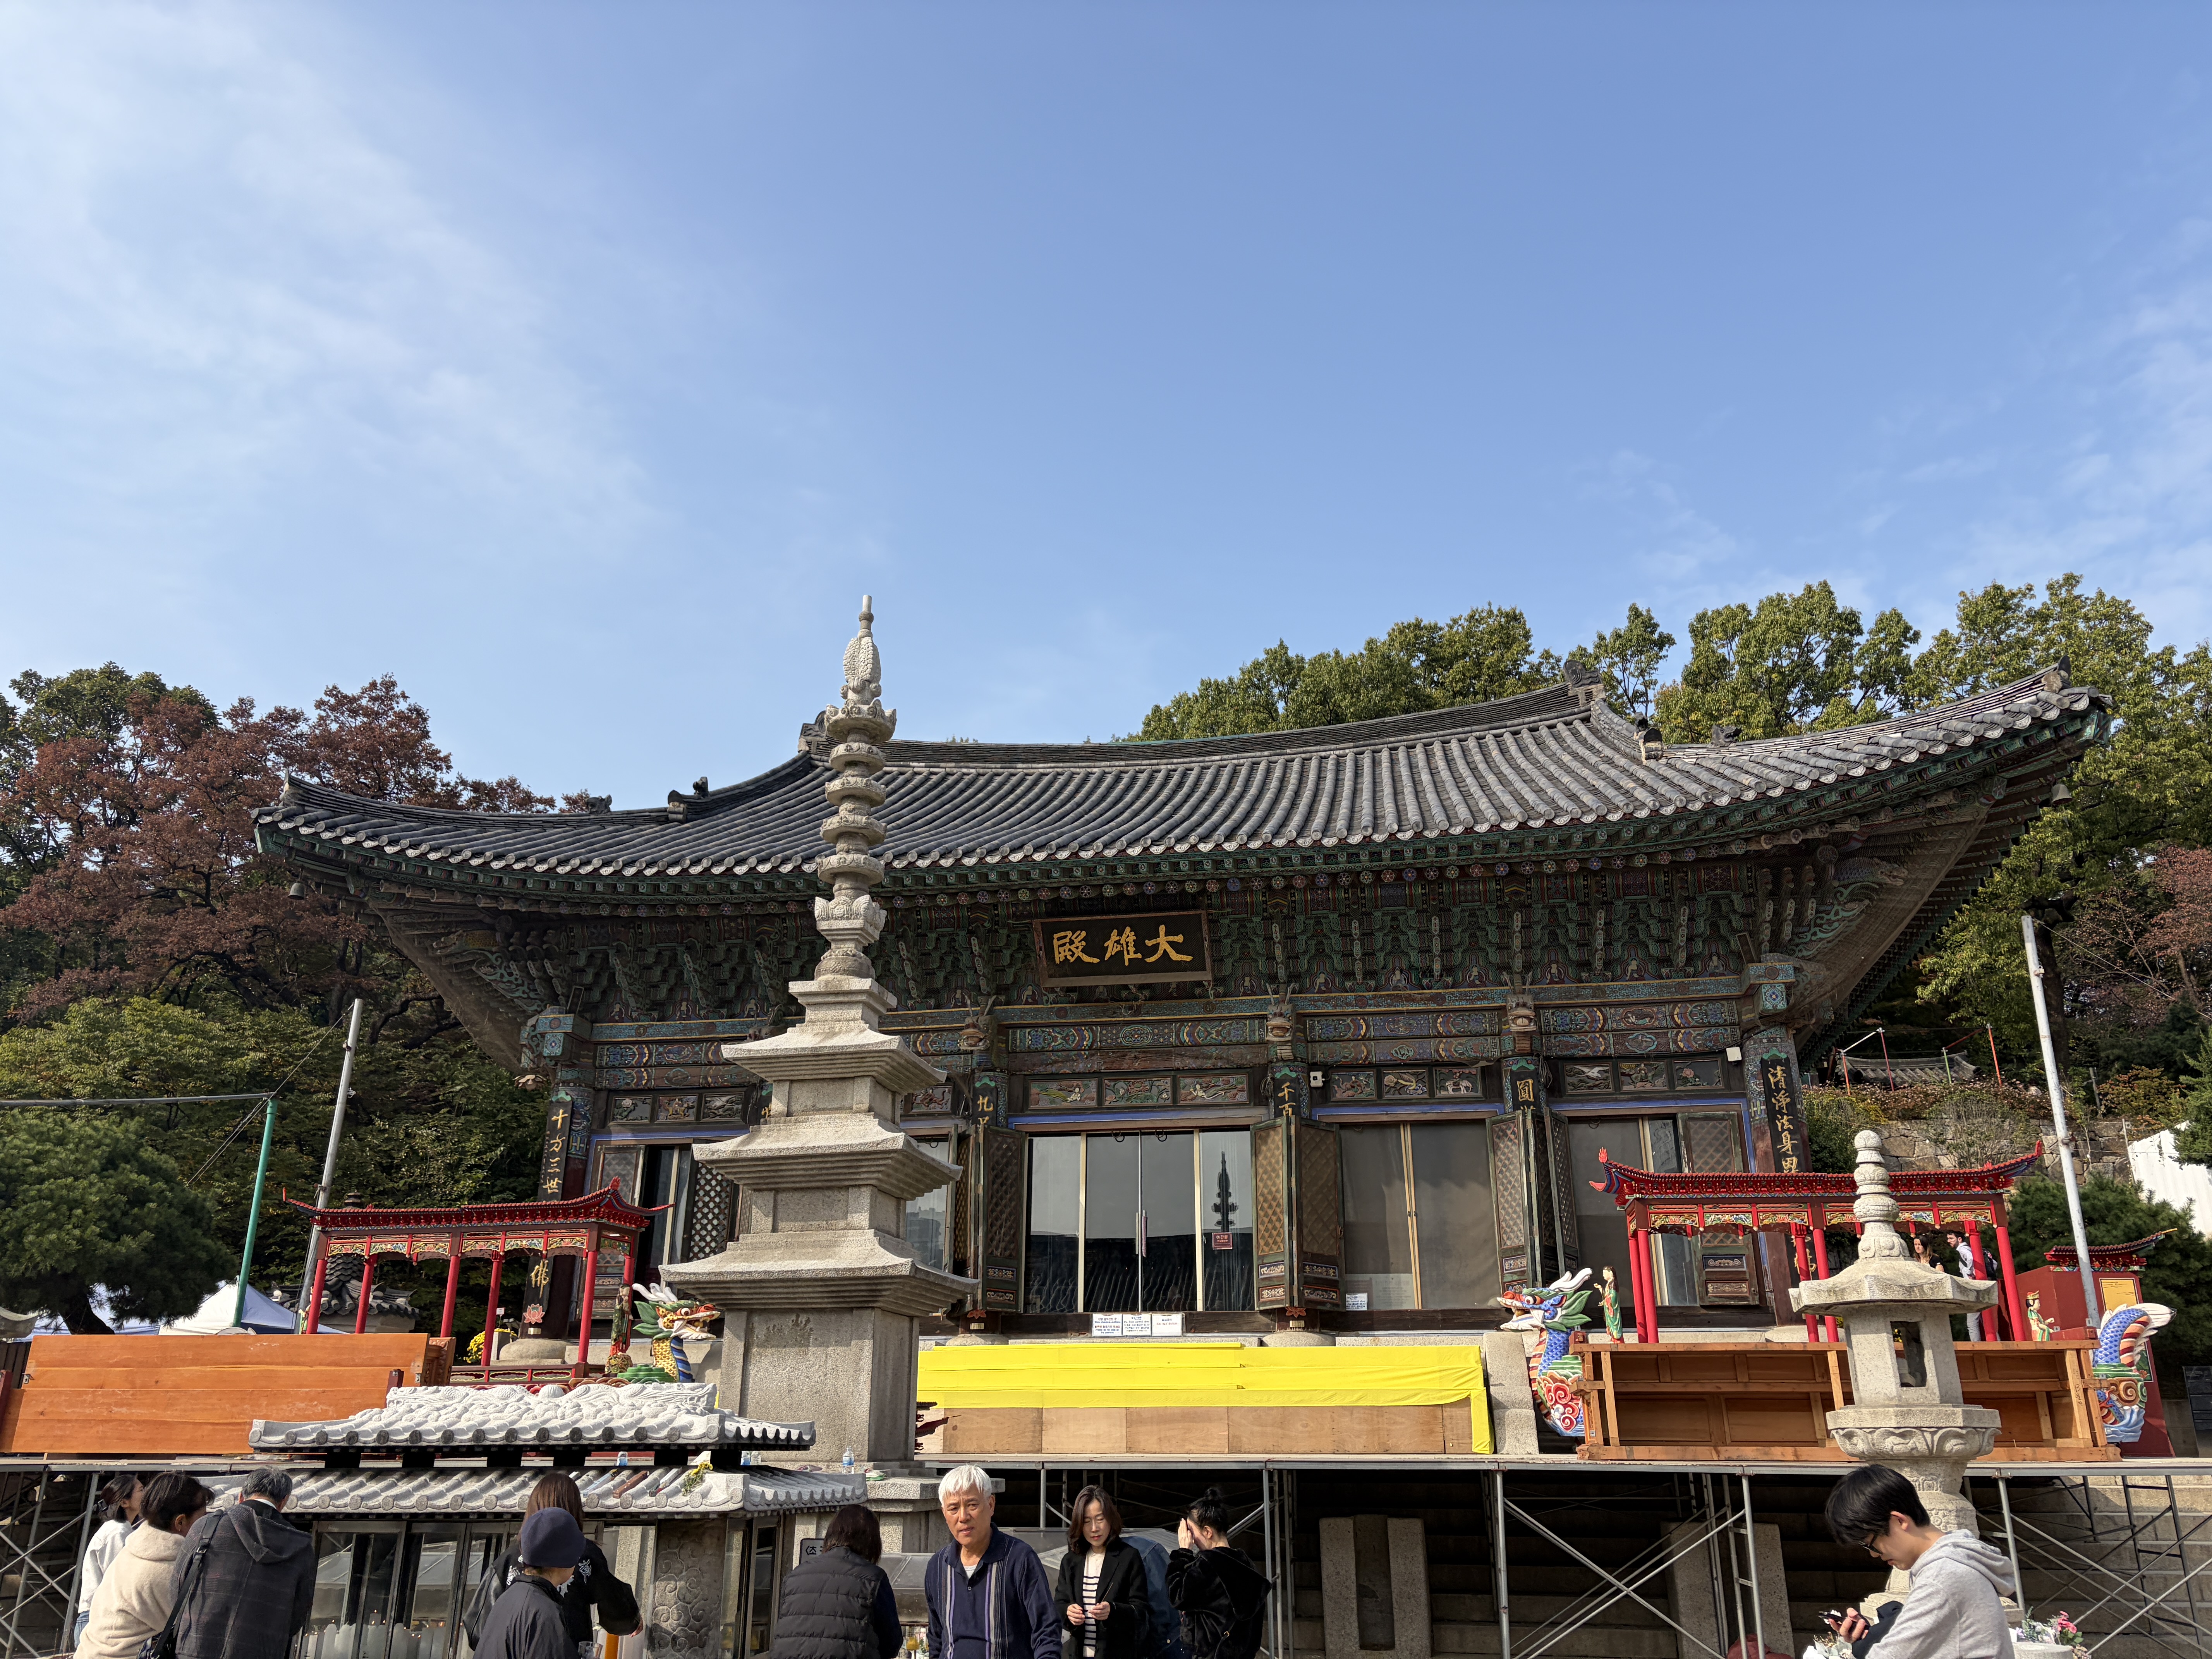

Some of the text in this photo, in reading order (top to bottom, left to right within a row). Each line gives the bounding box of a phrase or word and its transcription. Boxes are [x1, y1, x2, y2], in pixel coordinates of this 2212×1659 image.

[1053, 924, 1193, 966] 大雄殿
[1517, 1079, 1536, 1115] 圓
